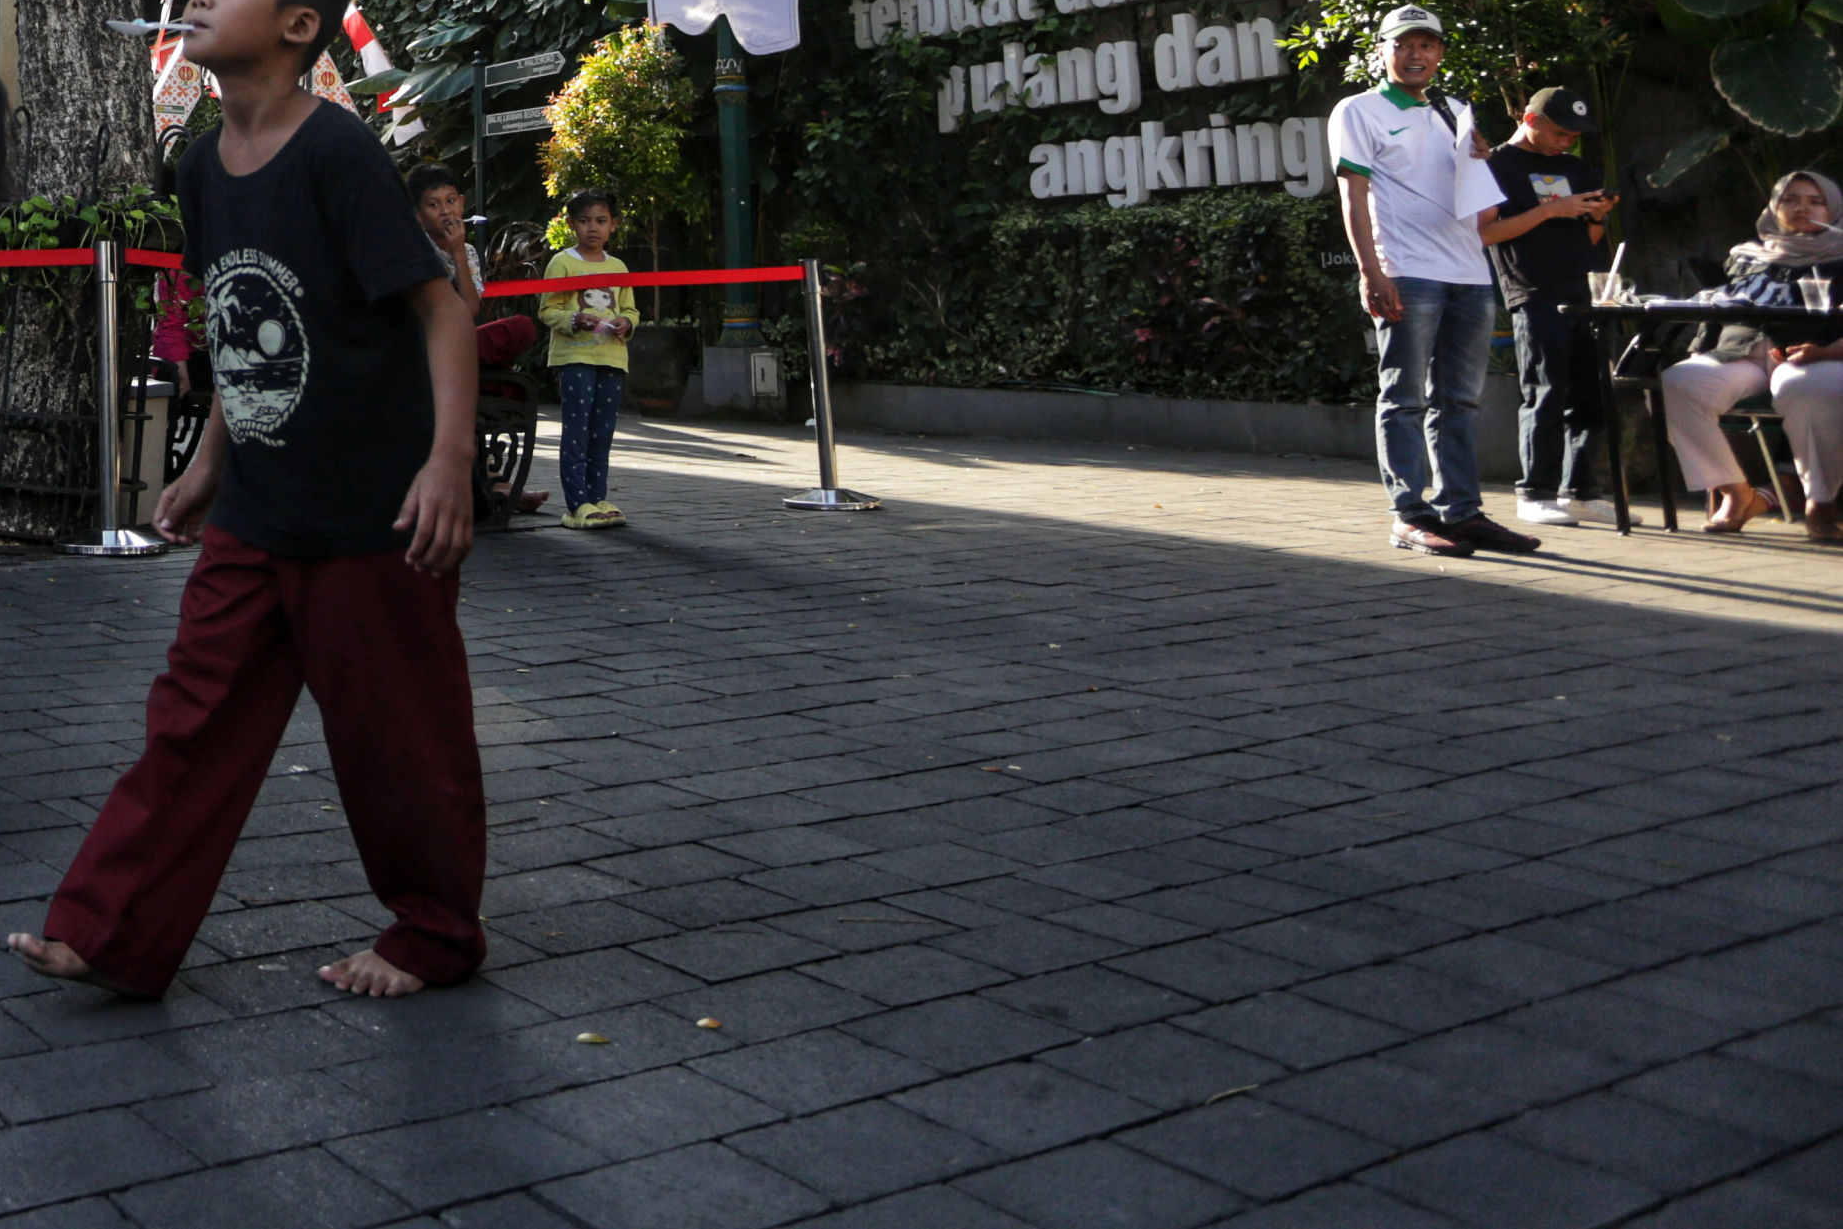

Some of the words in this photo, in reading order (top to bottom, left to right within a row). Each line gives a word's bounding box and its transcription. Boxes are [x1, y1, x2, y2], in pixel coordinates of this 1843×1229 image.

[938, 43, 1142, 134] pulang
[1154, 12, 1288, 93] dan
[220, 248, 258, 272] ENDLESS
[258, 251, 299, 292] SUMMER
